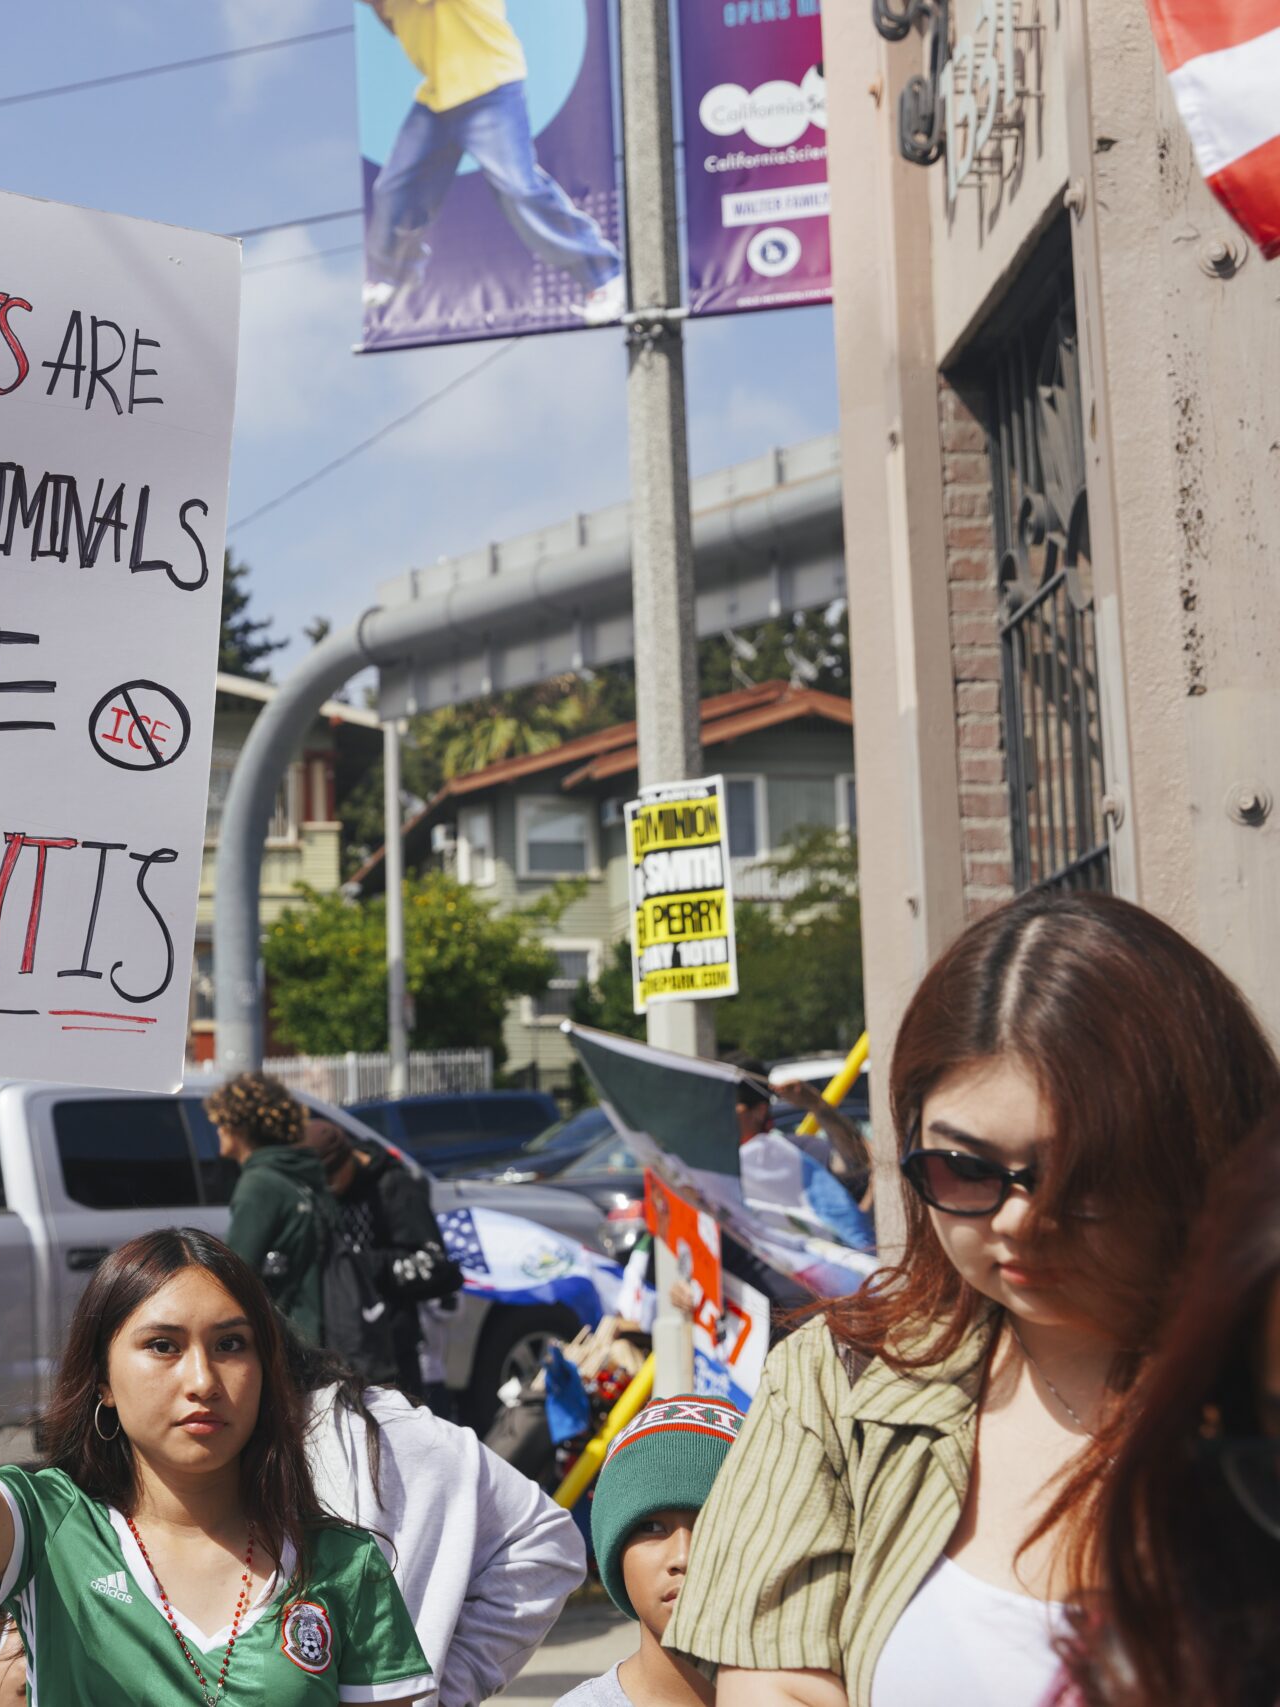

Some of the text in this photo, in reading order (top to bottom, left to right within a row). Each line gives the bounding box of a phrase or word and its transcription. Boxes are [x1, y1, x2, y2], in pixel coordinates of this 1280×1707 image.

[723, 0, 791, 27] OPENS
[711, 94, 826, 125] California Sc
[734, 198, 782, 216] WALTER
[41, 310, 164, 415] ARE
[102, 706, 171, 757] ICE
[56, 838, 180, 1004] IS
[652, 898, 723, 938] PERRY
[90, 1580, 133, 1604] adidas
